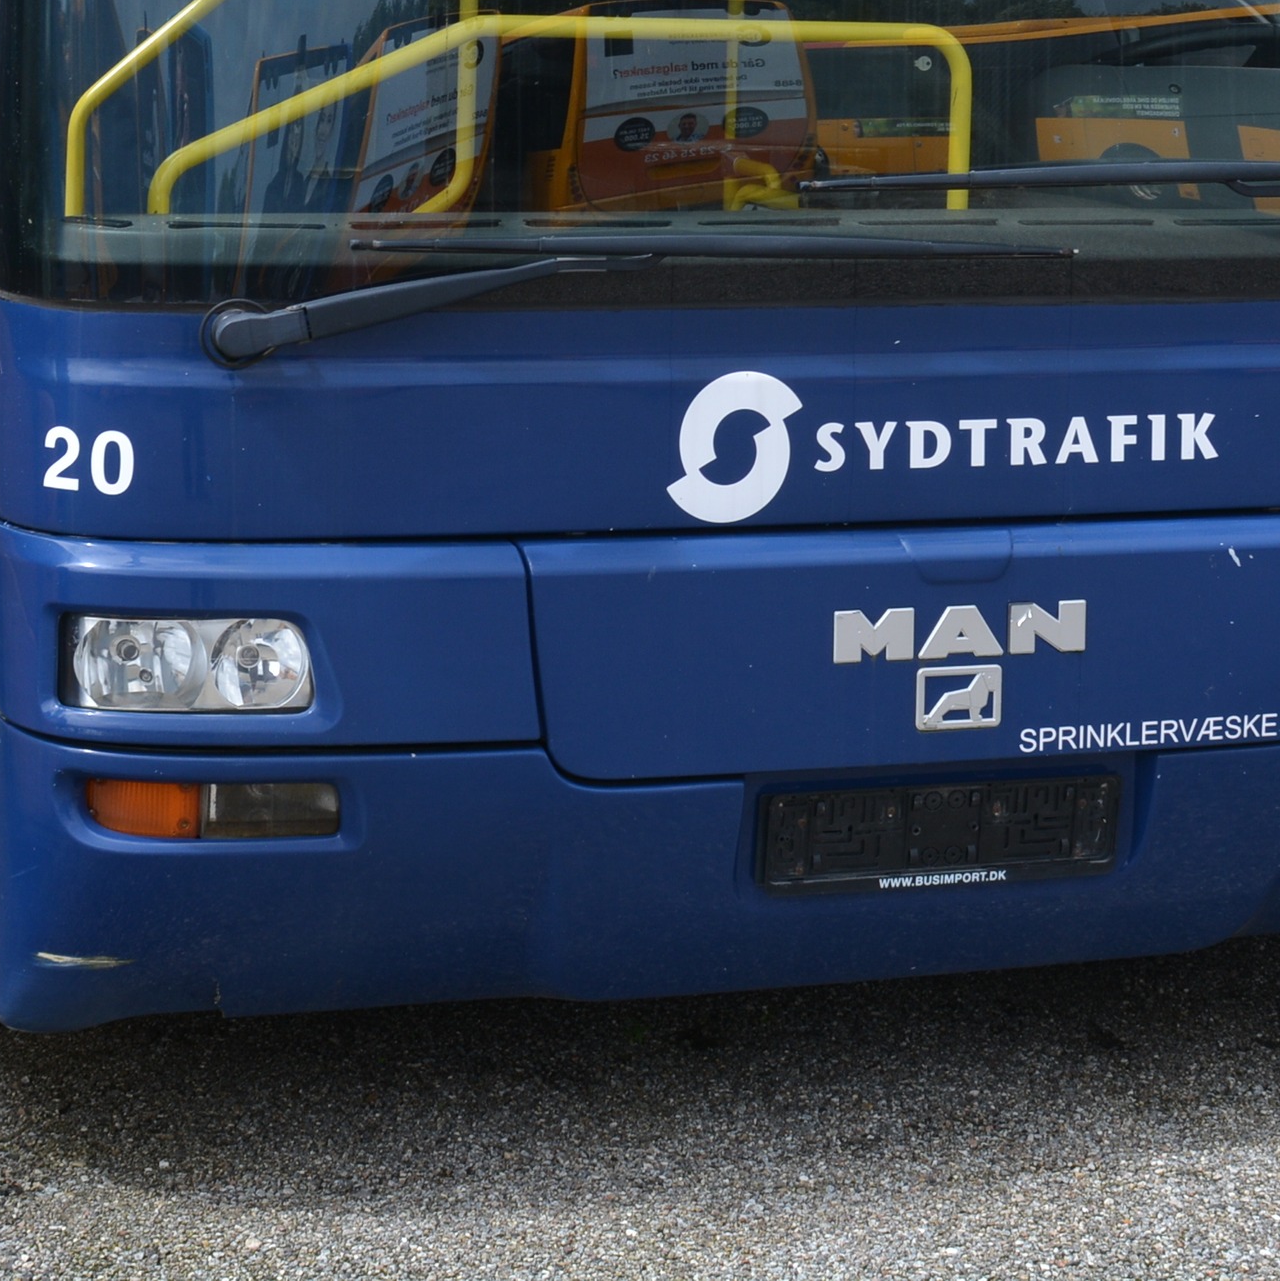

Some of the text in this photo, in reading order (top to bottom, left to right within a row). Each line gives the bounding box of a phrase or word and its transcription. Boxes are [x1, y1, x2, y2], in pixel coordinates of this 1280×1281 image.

[42, 425, 135, 496] 20
[814, 412, 1219, 472] SYDTRAFIK
[833, 599, 1087, 663] MAN
[1019, 713, 1278, 753] SPRINKLERVÆSKE
[879, 869, 1007, 890] WWW.BUSIMPORT.DK
